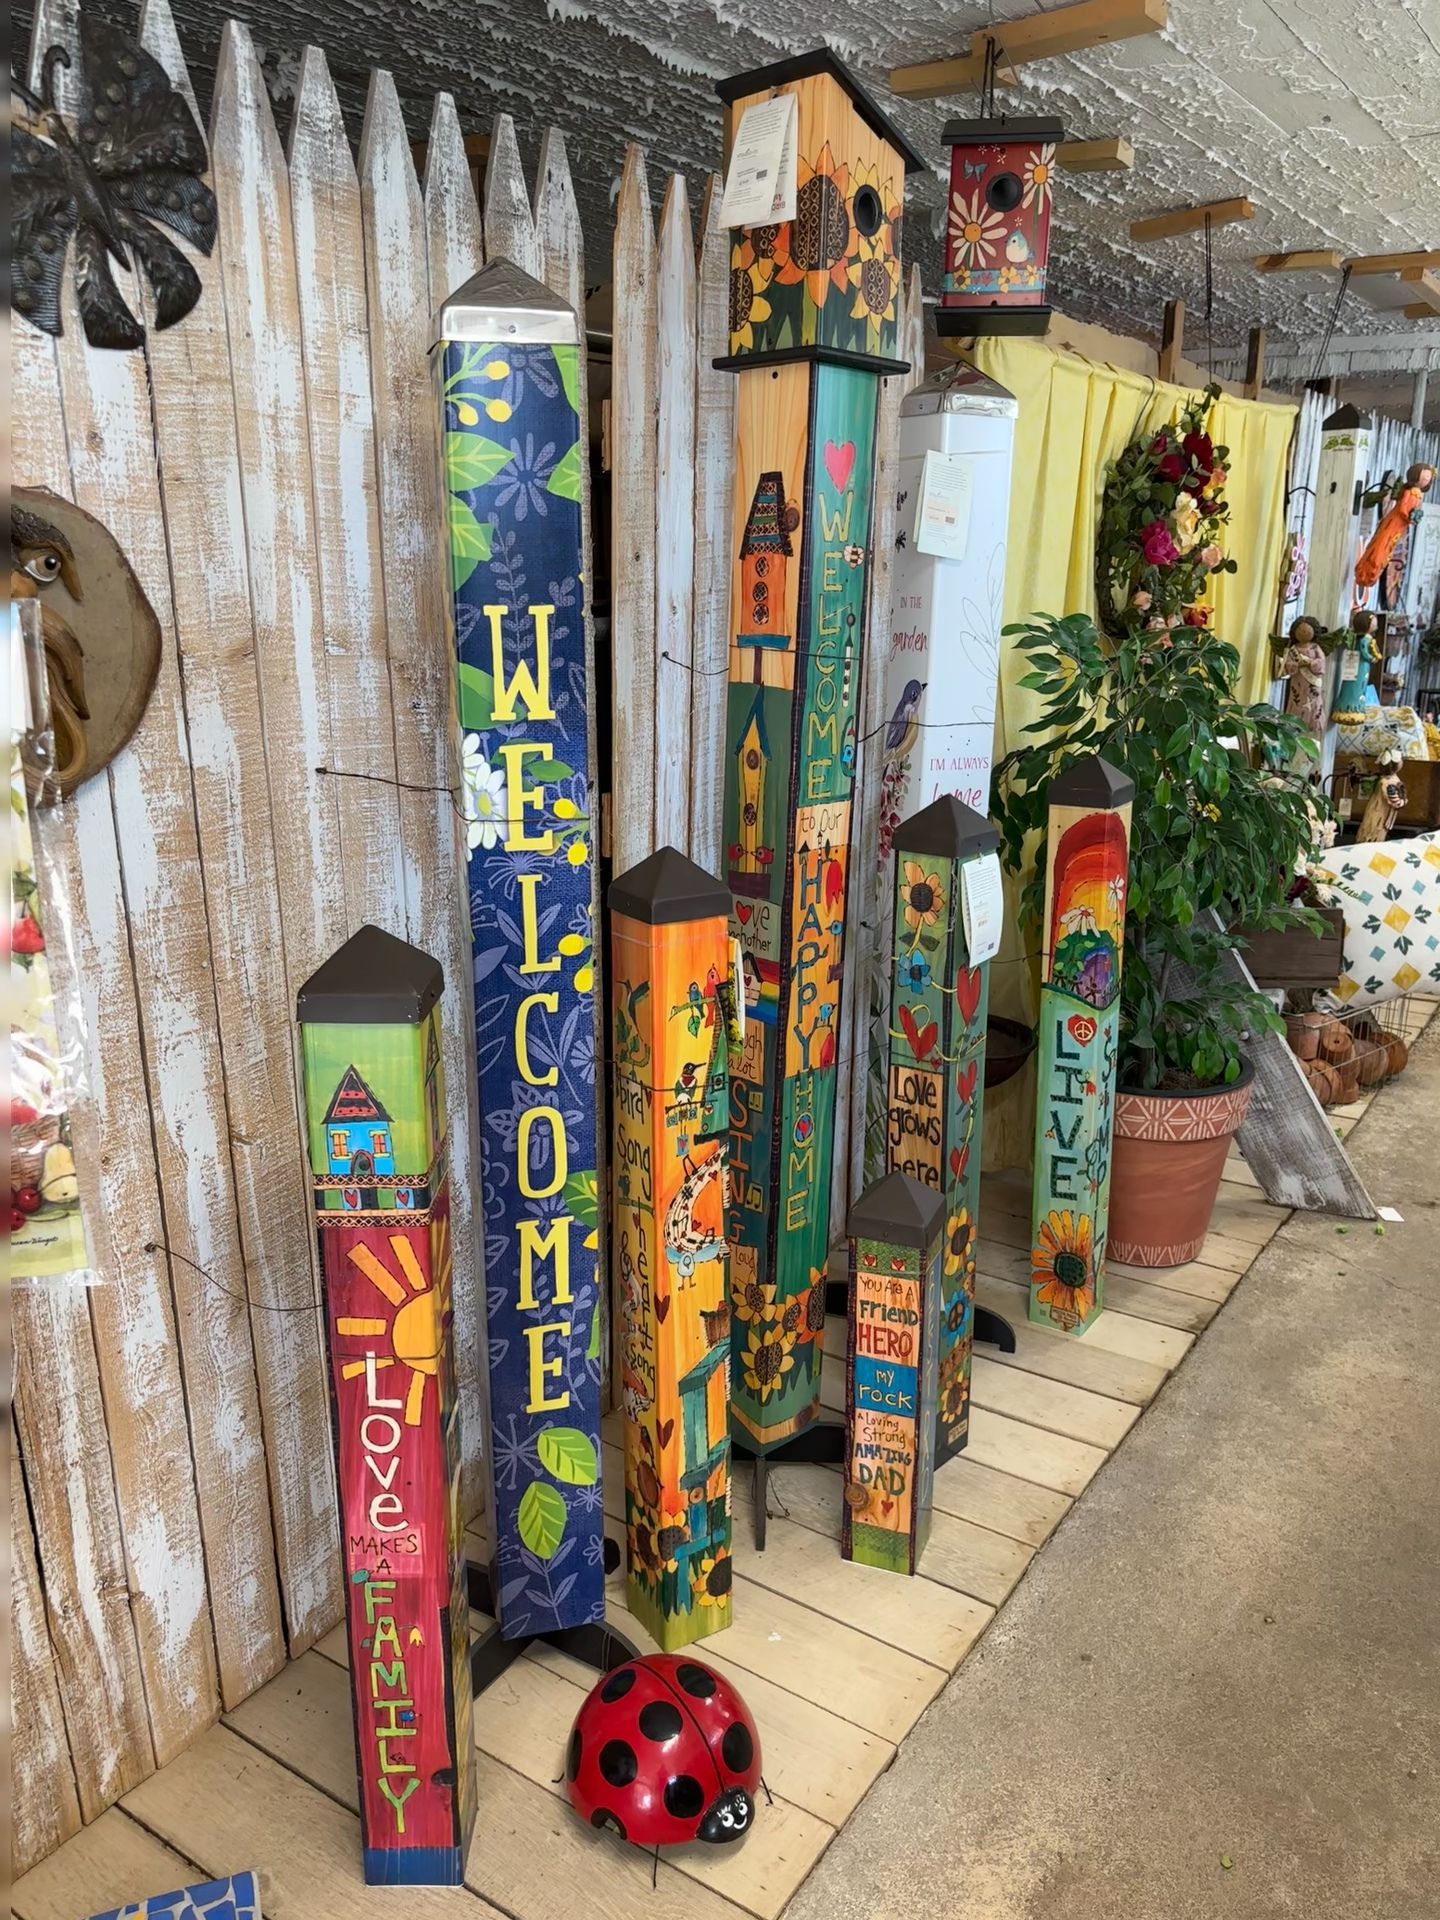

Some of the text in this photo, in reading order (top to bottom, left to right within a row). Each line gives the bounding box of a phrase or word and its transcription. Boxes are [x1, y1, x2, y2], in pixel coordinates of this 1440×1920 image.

[900, 596, 922, 609] IN THE
[807, 490, 853, 799] WELCOME
[890, 625, 928, 662] garden
[930, 757, 989, 771] I'M ALWAYS
[801, 816, 815, 832] to
[794, 858, 823, 1070] HAPPY
[484, 604, 574, 1414] WELCOME
[894, 1066, 937, 1109] Love
[889, 1106, 941, 1146] grows
[1049, 1019, 1084, 1200] LIVE
[617, 1123, 651, 1201] Song
[786, 1070, 816, 1232] HOME
[889, 1146, 939, 1191] here
[885, 1279, 903, 1295] Are
[905, 1286, 915, 1303] A
[858, 1322, 914, 1358] HERO
[876, 1369, 895, 1388] my
[862, 1427, 906, 1450] Strong
[866, 1412, 899, 1432] Loving
[360, 1350, 409, 1533] Love
[855, 1443, 913, 1467] AMAZING
[858, 1462, 906, 1497] DAD
[350, 1534, 418, 1555] MAKES
[376, 1557, 392, 1575] A
[364, 1580, 421, 1834] FAMILY
